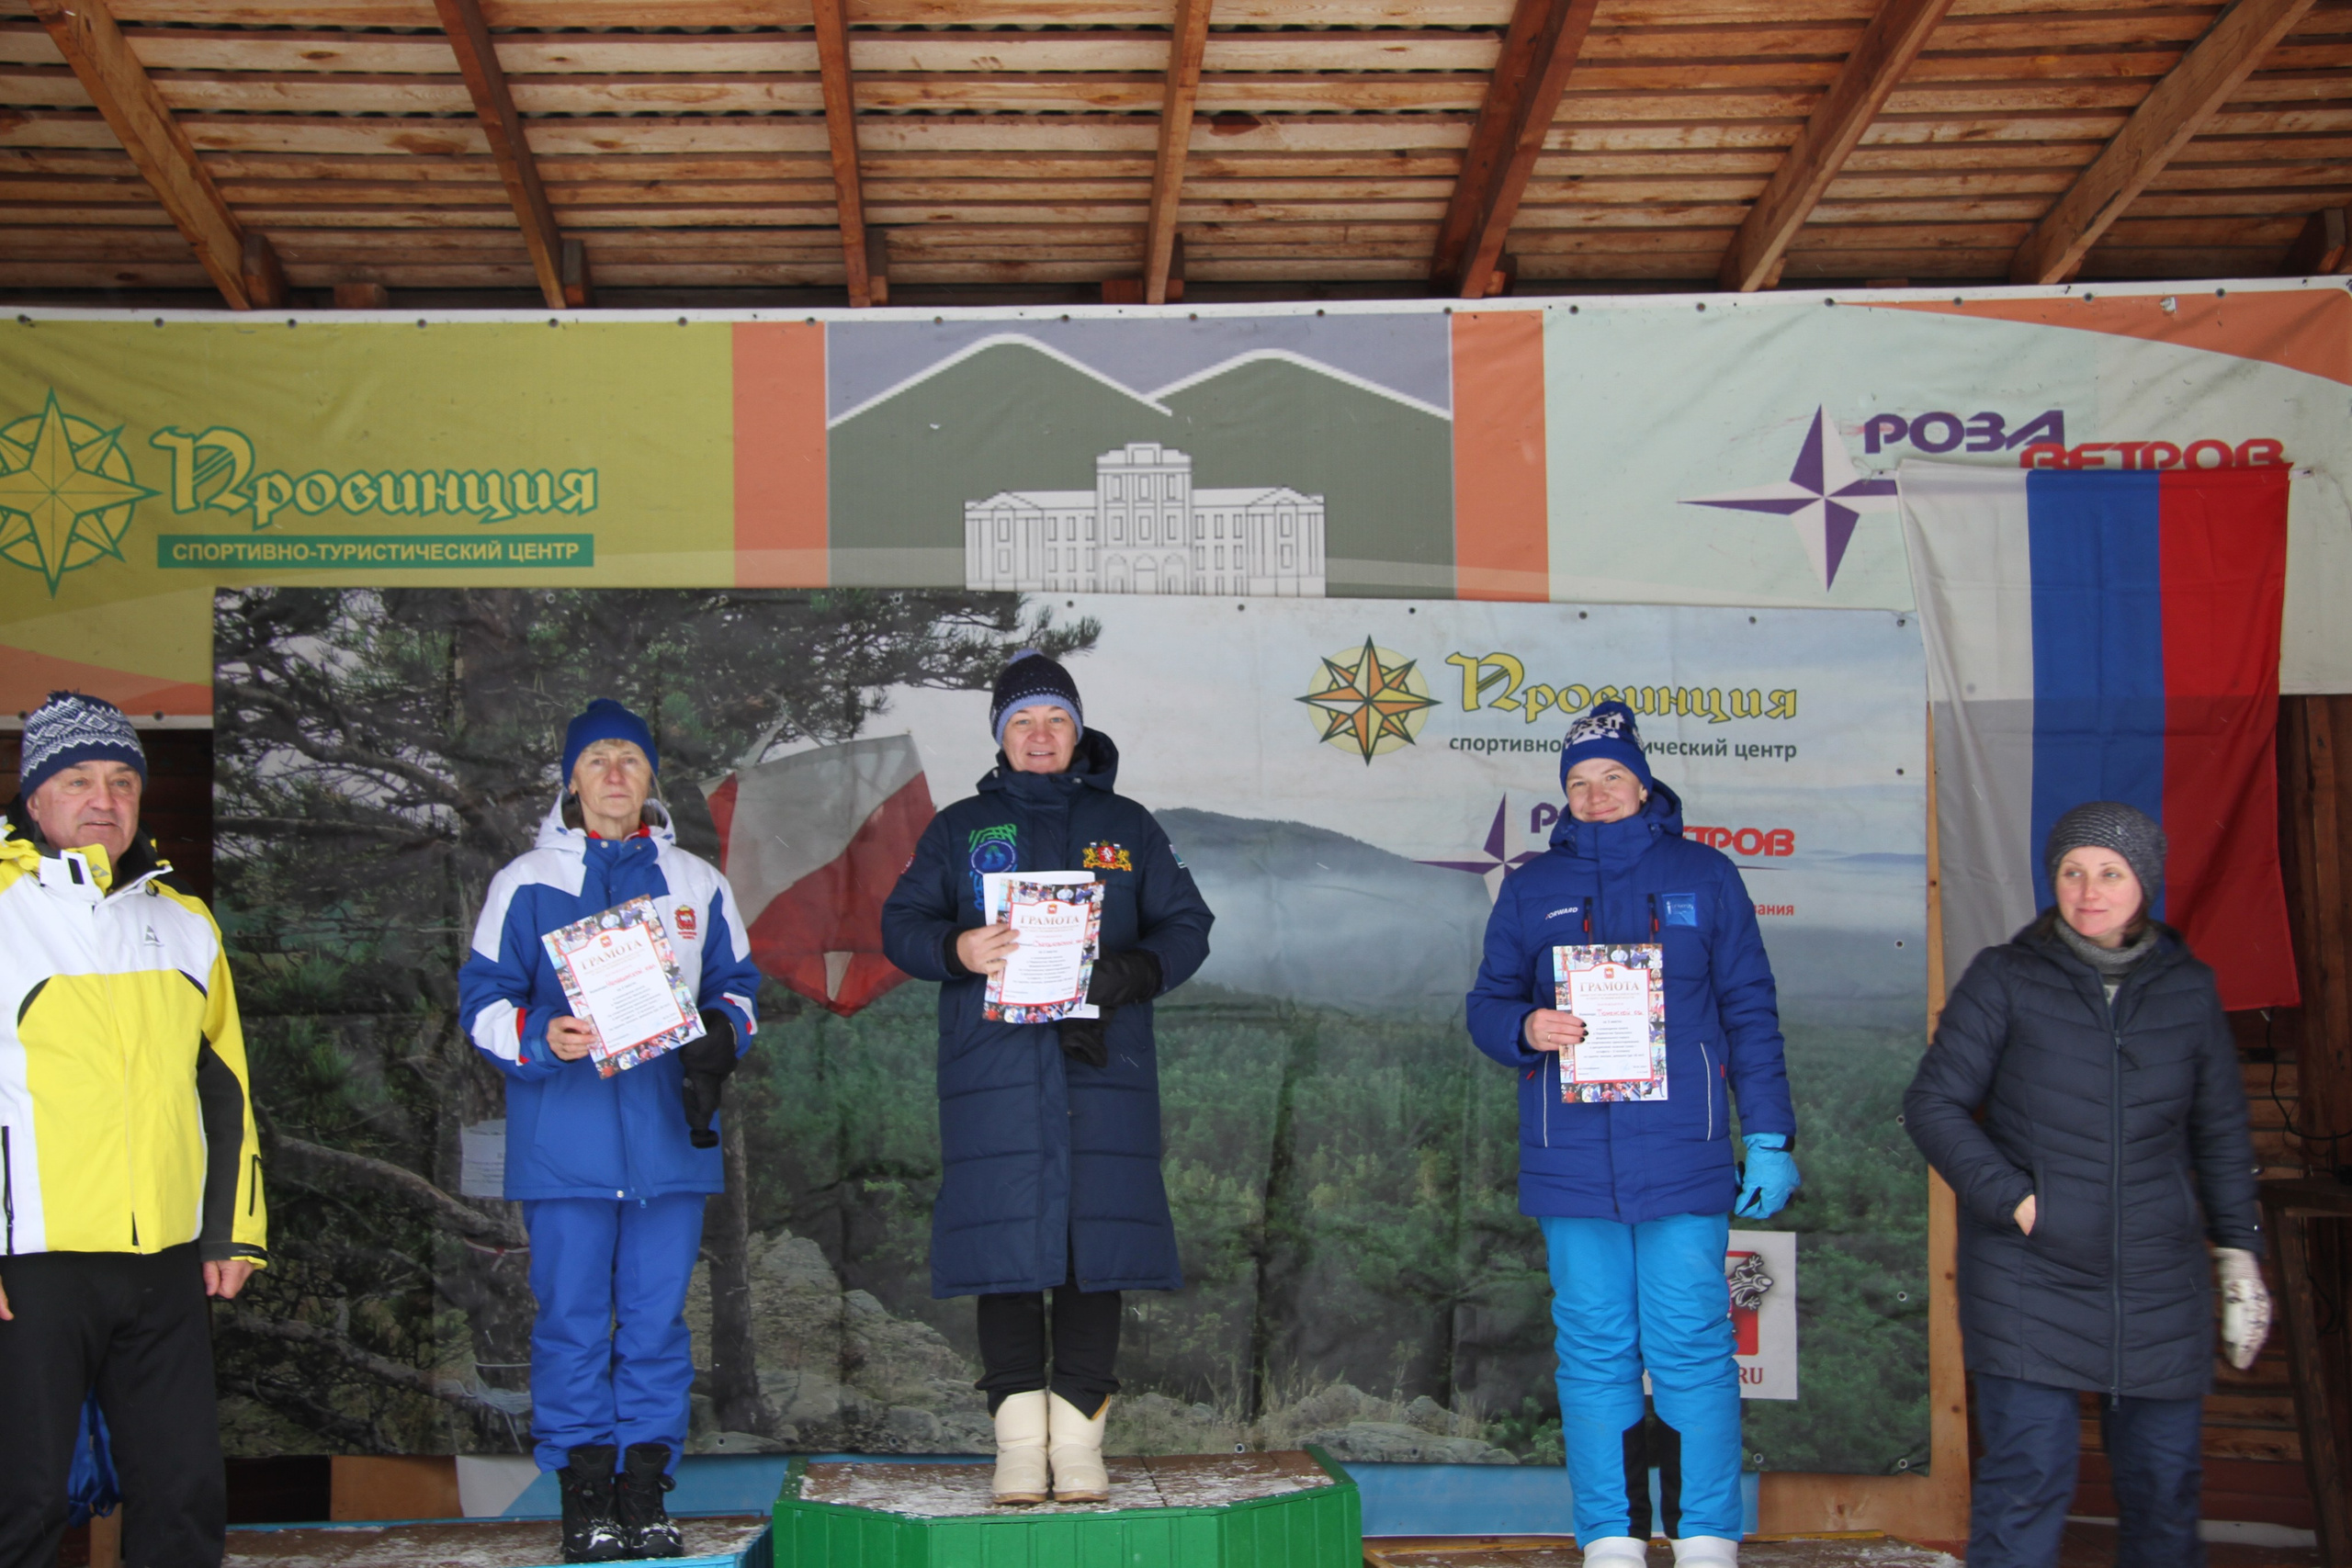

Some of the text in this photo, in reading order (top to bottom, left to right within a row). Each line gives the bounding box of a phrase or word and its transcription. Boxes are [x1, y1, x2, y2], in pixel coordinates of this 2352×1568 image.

[1864, 410, 2064, 454] РОЗА
[149, 426, 598, 531] Провинция
[172, 540, 580, 562] СПОРТИВНО-ТУРИСТИЧЕСКИЙ ЦЕНТР
[1444, 651, 1797, 724] Провинция
[1735, 742, 1797, 761] центр
[1683, 826, 1794, 856] ТРОВ
[1020, 915, 1080, 925] ГРАМОТА
[580, 938, 643, 970] ГРАМОТА
[1579, 981, 1640, 992] ГРАМОТА
